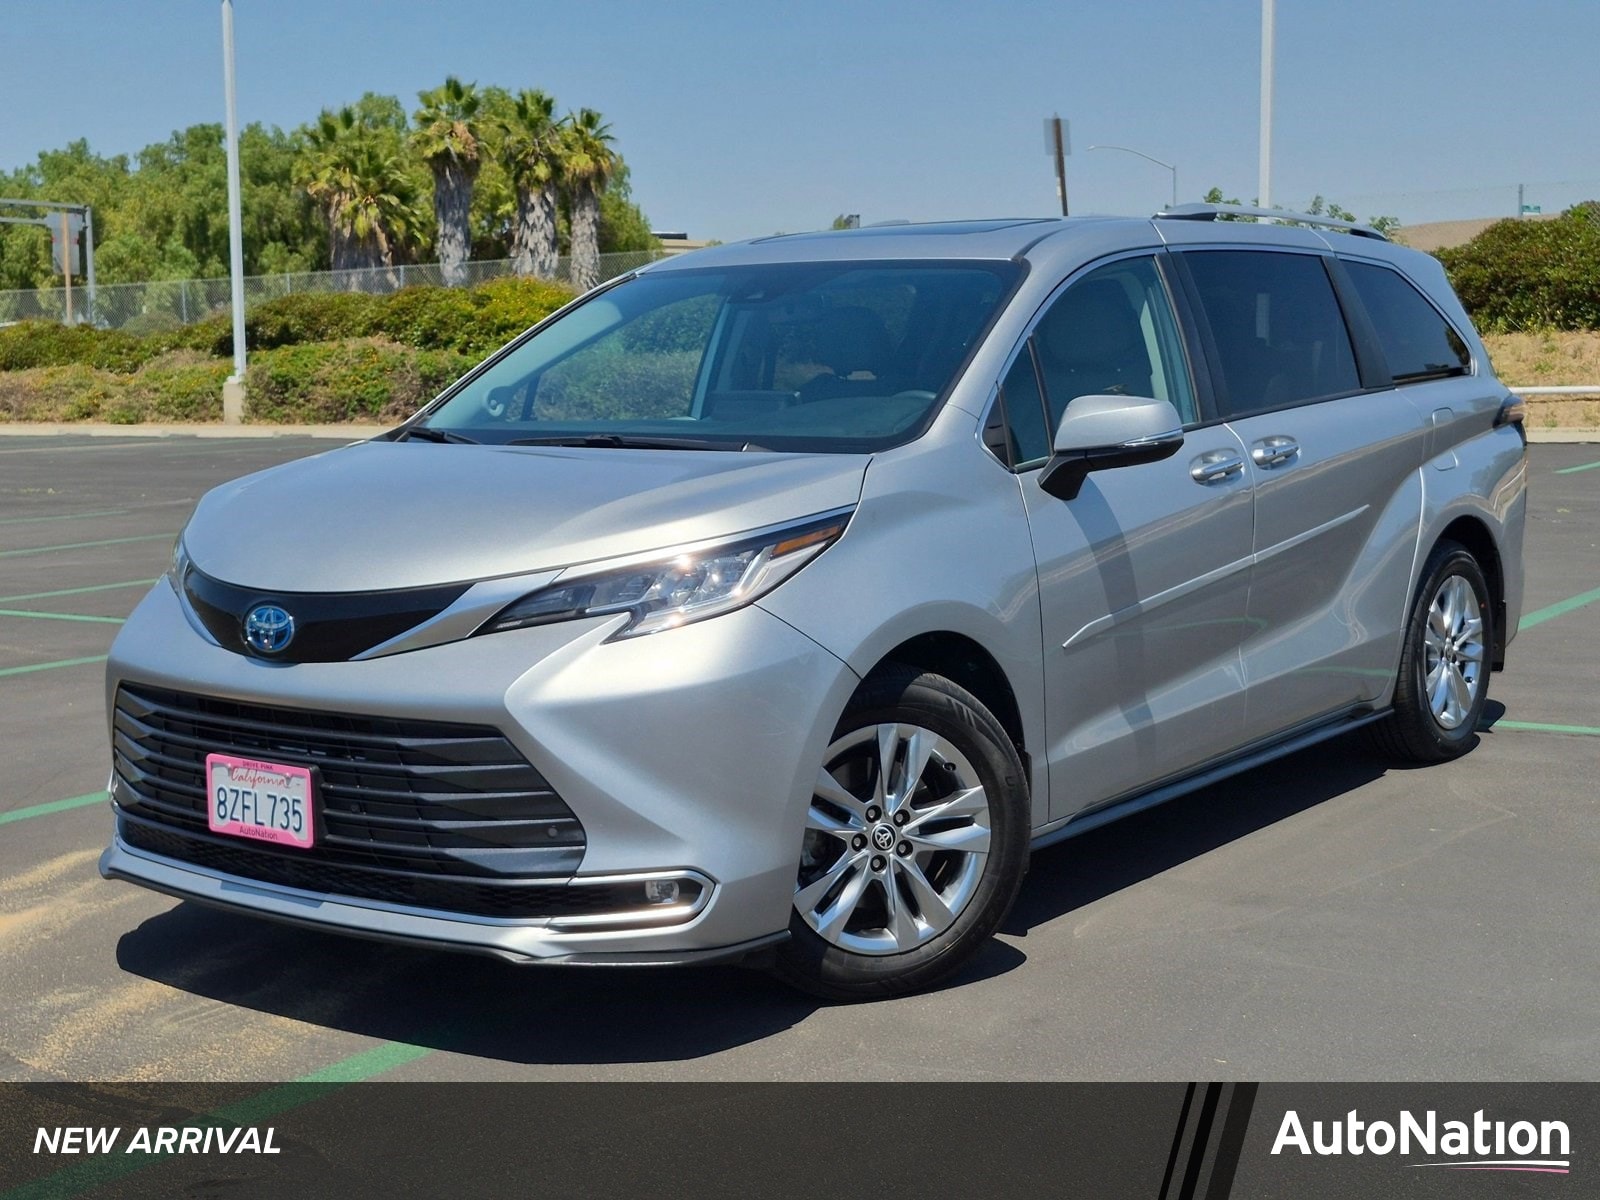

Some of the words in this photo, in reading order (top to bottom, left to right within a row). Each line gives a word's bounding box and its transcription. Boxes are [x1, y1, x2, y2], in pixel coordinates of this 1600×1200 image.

[231, 767, 288, 789] California
[217, 786, 303, 833] 8ZFL735
[239, 826, 278, 840] AutoNation
